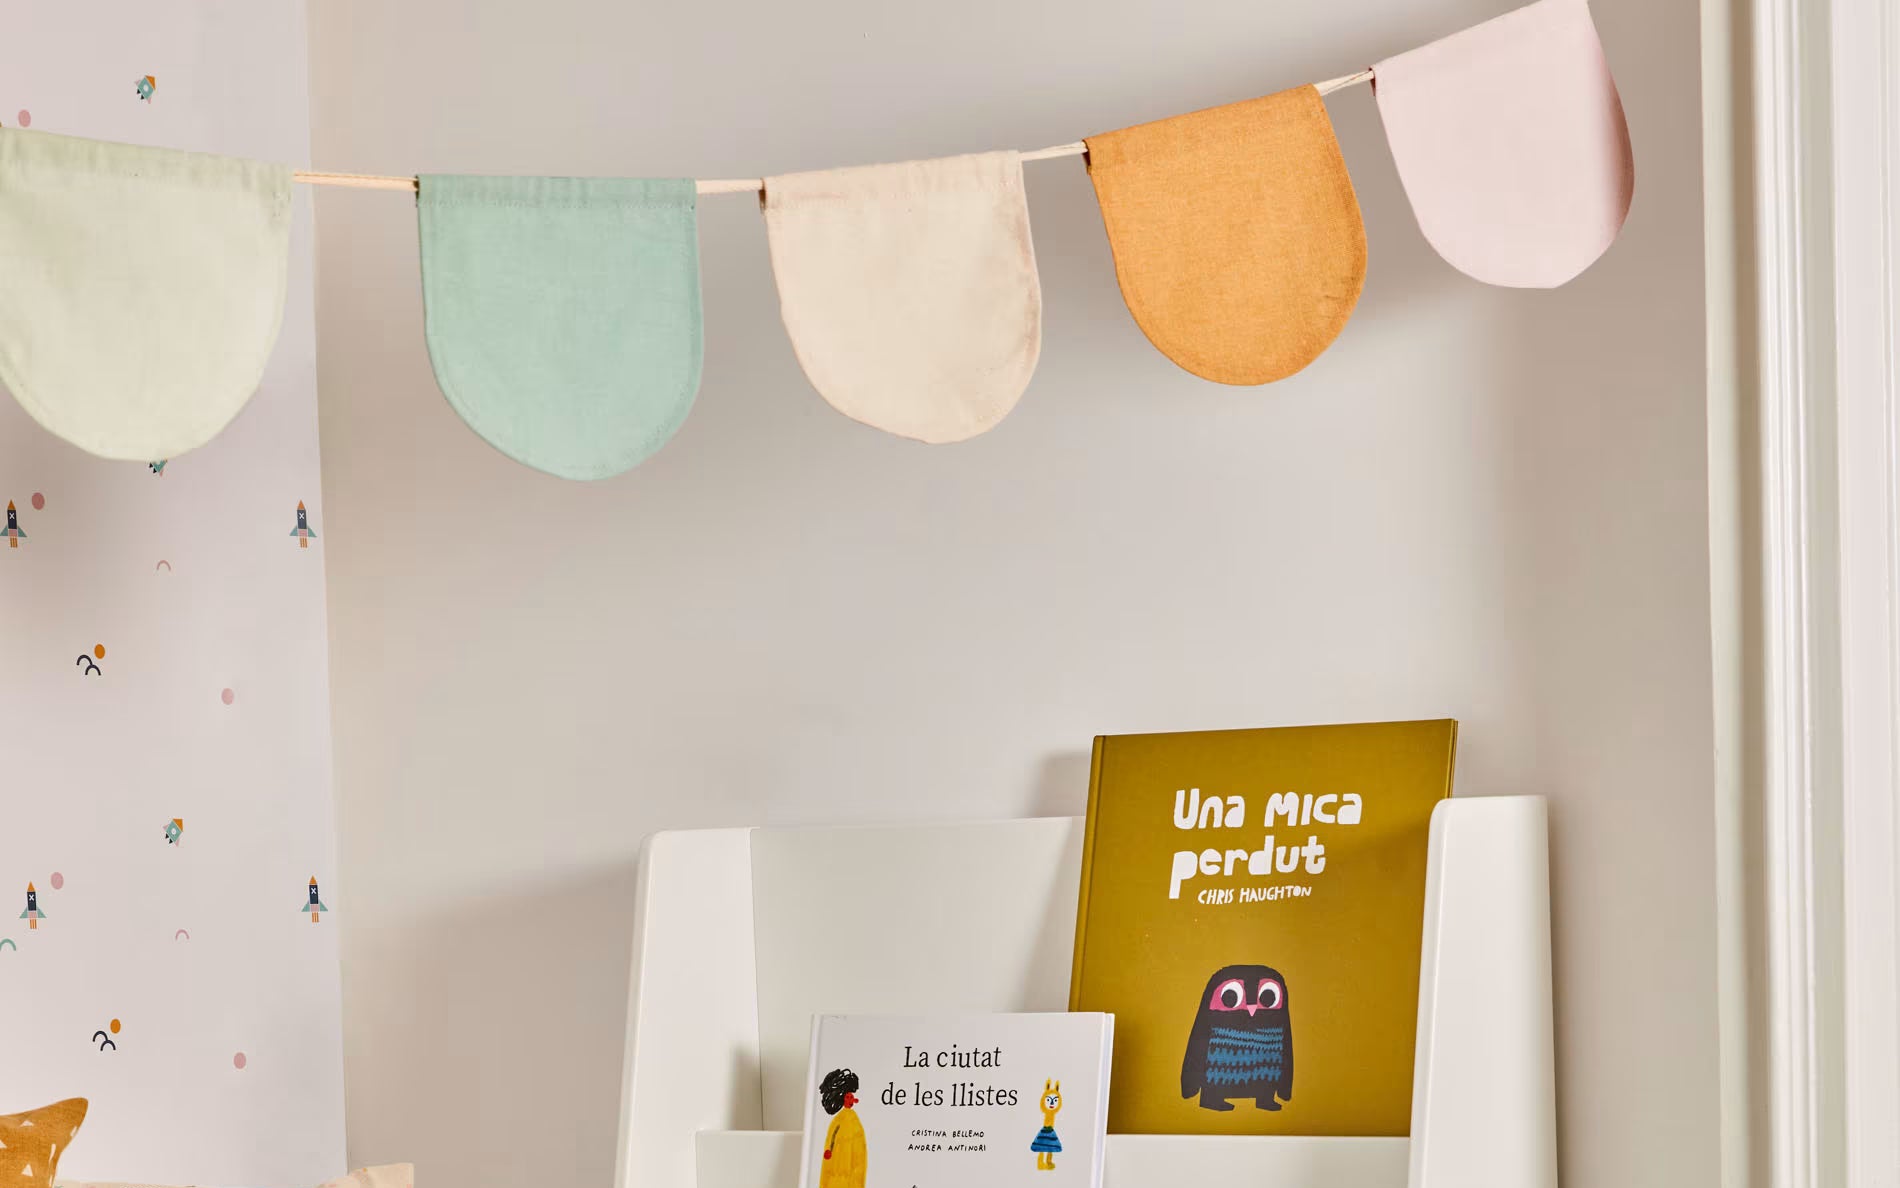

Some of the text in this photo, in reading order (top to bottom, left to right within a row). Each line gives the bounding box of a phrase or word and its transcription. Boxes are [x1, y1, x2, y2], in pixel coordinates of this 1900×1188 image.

[1174, 788, 1245, 830] Una
[1169, 835, 1326, 900] perdut
[1198, 885, 1312, 905] CHRIS HAUGHTON
[904, 1044, 1002, 1069] La ciutat
[881, 1082, 1019, 1108] de les llistes
[911, 1128, 985, 1139] CRISTINA BELLEMO
[908, 1143, 986, 1152] ANDREA ANTINORI
